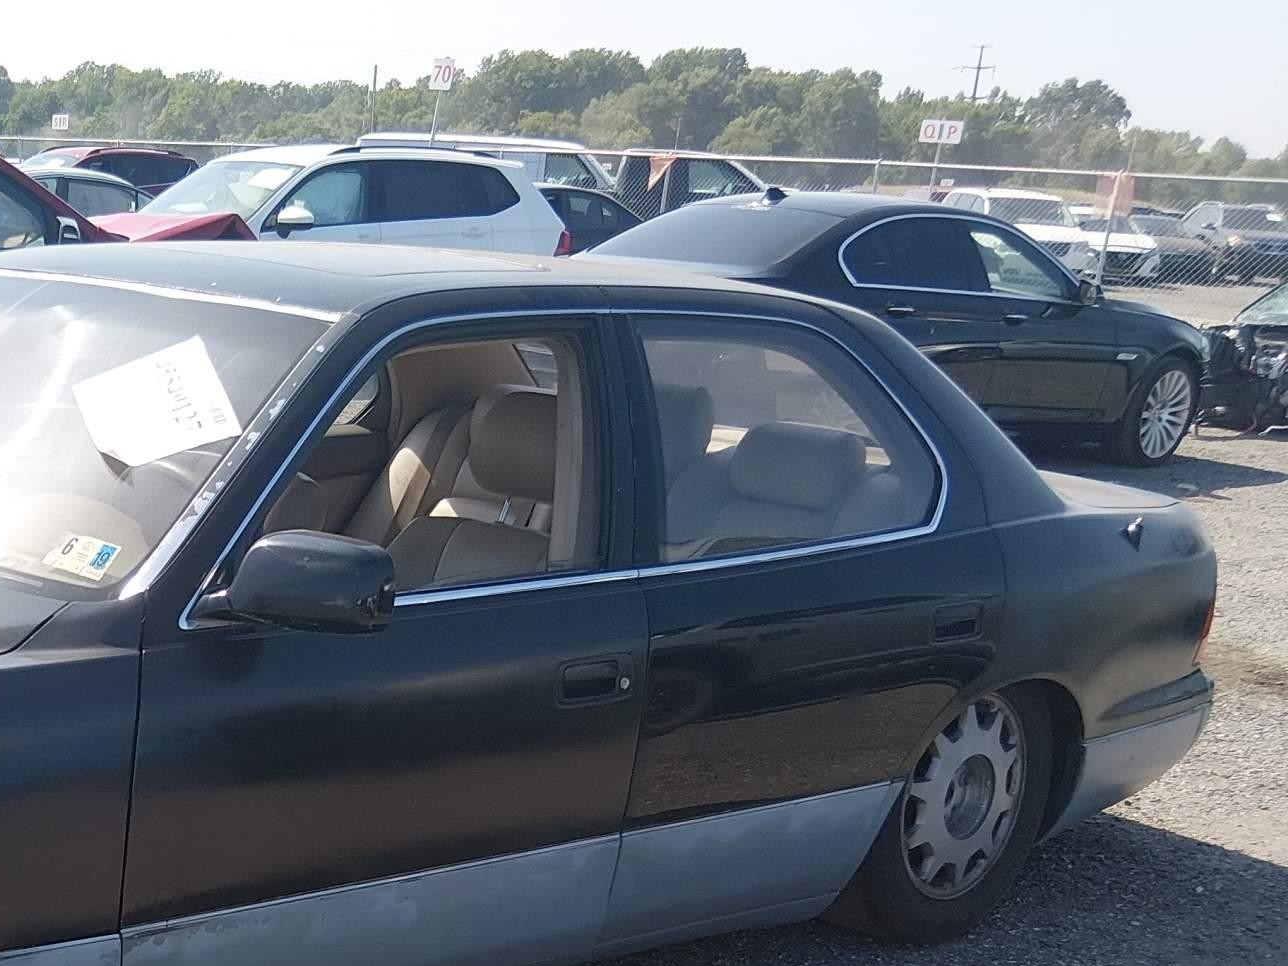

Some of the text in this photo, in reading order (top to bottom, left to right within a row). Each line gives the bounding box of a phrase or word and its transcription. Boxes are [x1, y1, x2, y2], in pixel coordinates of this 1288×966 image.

[433, 64, 452, 84] 70
[923, 124, 958, 140] Q P
[61, 537, 79, 556] 6
